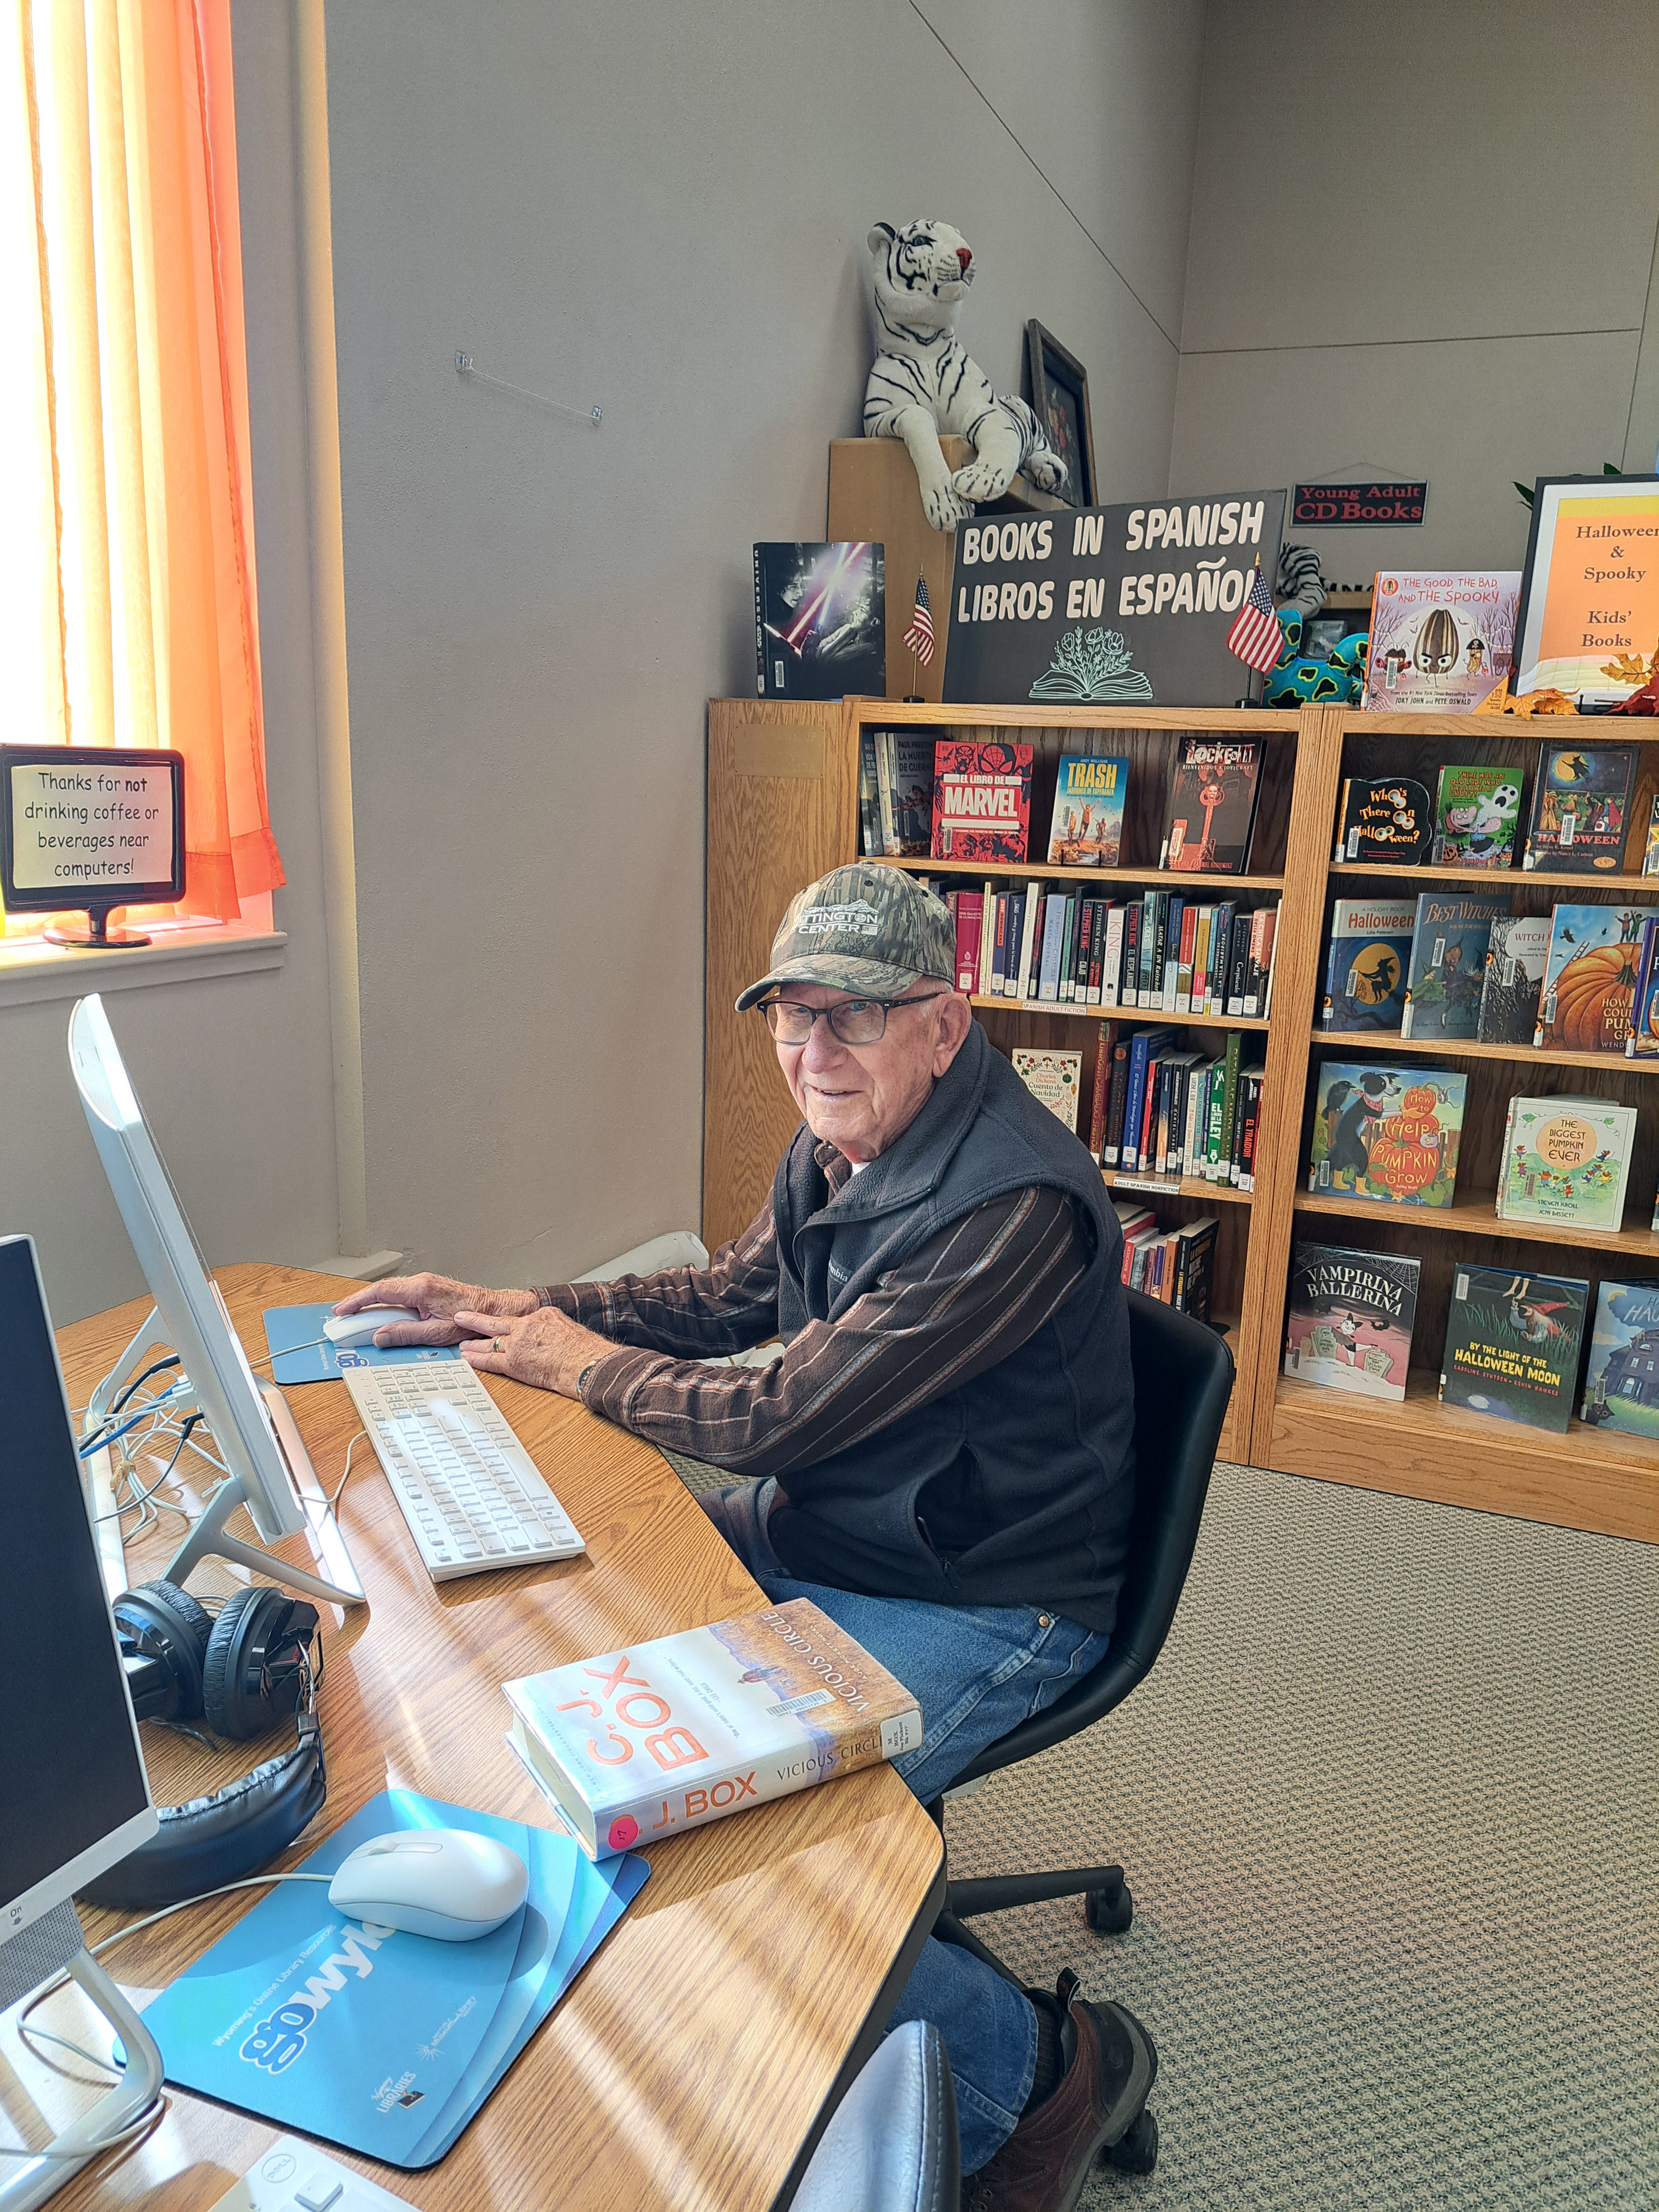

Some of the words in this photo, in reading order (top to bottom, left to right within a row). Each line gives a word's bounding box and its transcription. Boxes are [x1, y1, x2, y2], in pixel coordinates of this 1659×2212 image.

[1301, 487, 1360, 500] Young
[1366, 486, 1420, 498] Adult
[1295, 502, 1338, 520] CD
[1342, 502, 1422, 520] Books
[963, 520, 1053, 564] BOOKS
[1073, 515, 1104, 555] IN
[1126, 501, 1264, 551] SPANISH
[1610, 546, 1625, 558] &
[1584, 566, 1647, 583] Spooky
[1403, 578, 1421, 587] THE
[1424, 578, 1454, 589] GOOD,
[1457, 578, 1476, 587] THE
[1478, 578, 1498, 589] BAD,
[958, 581, 1054, 622] LIBROS
[1066, 578, 1105, 619] EN
[1398, 593, 1416, 603] AND
[1417, 590, 1441, 602] THE
[1443, 591, 1500, 605] SPOOKY
[1587, 610, 1632, 624] Kids'
[1581, 634, 1632, 647] Books
[38, 772, 91, 791] Thanks
[97, 774, 121, 792] for
[125, 778, 147, 792] not
[960, 774, 968, 784] EL
[970, 775, 993, 784] LIBRO
[994, 775, 1005, 785] DE
[1068, 763, 1117, 789] TRASH
[944, 786, 1018, 817] MARVEL
[24, 801, 88, 824] drinking
[94, 803, 141, 819] coffee
[145, 807, 159, 819] or
[1360, 806, 1390, 820] There
[38, 831, 114, 852] beverages
[120, 834, 149, 847] near
[55, 858, 134, 880] computers!
[1082, 909, 1091, 933] STEPHEN
[1129, 908, 1138, 931] STEPHEN
[1259, 914, 1264, 923] LA
[1348, 913, 1414, 929] Halloween
[1423, 903, 1458, 925] BEST
[798, 924, 860, 934] CENTER
[1515, 933, 1545, 941] WITCH
[1081, 935, 1089, 948] KING
[1107, 921, 1122, 959] KING
[1129, 933, 1137, 945] KING
[1156, 954, 1161, 963] UN
[1253, 948, 1261, 976] SALVAJE
[1233, 962, 1244, 993] Crepúsculo
[1602, 998, 1628, 1007] HOW
[1028, 1082, 1053, 1090] Cuento
[1031, 1089, 1060, 1097] Navidad
[1212, 1103, 1222, 1112] EL
[1210, 1121, 1222, 1139] LEY
[1246, 1118, 1254, 1127] EL
[1391, 1122, 1429, 1137] Help
[1561, 1119, 1578, 1128] THE
[1549, 1129, 1586, 1139] BIGGEST
[1243, 1129, 1253, 1158] TRAIDOR
[1548, 1139, 1584, 1150] PUMPKIN
[1372, 1144, 1436, 1170] PUMPKIN
[1548, 1150, 1581, 1162] EVER
[1306, 1265, 1403, 1302] VAMPIRINA
[1306, 1281, 1403, 1317] BALLERINA
[1470, 1342, 1481, 1351] BY
[1482, 1345, 1496, 1356] THE
[1498, 1349, 1520, 1361] LIGHT
[1522, 1355, 1531, 1363] OF
[1533, 1357, 1547, 1369] THE
[1455, 1349, 1524, 1378] HALLOWEEN
[1527, 1370, 1560, 1387] MOON
[1454, 1365, 1480, 1376] CAROLINE
[1514, 1380, 1531, 1389] KEVIN
[1535, 1386, 1559, 1396] HAWKES
[761, 1611, 812, 1653] CIRCLE
[809, 1624, 828, 1641] NOVEL
[826, 1642, 851, 1664] PICKETT
[849, 1664, 863, 1675] JOE
[807, 1656, 870, 1712] VICIOUS
[582, 1655, 710, 1771] BOX
[538, 1707, 564, 1740] BESTSELLING
[562, 1741, 576, 1757] TIMES
[575, 1757, 588, 1772] YORK
[586, 1774, 597, 1785] NEW
[685, 1771, 759, 1818] BOX
[777, 1751, 834, 1781] VICIOUS
[841, 1736, 883, 1759] CIRCL
[10, 1906, 22, 1918] On
[212, 2004, 257, 2047] Wyoming's
[254, 1981, 279, 2006] Online
[276, 1956, 304, 1984] Library
[300, 1924, 337, 1959] Resources
[376, 2071, 416, 2113] LIBRARIES
[267, 2156, 292, 2179] DELL
